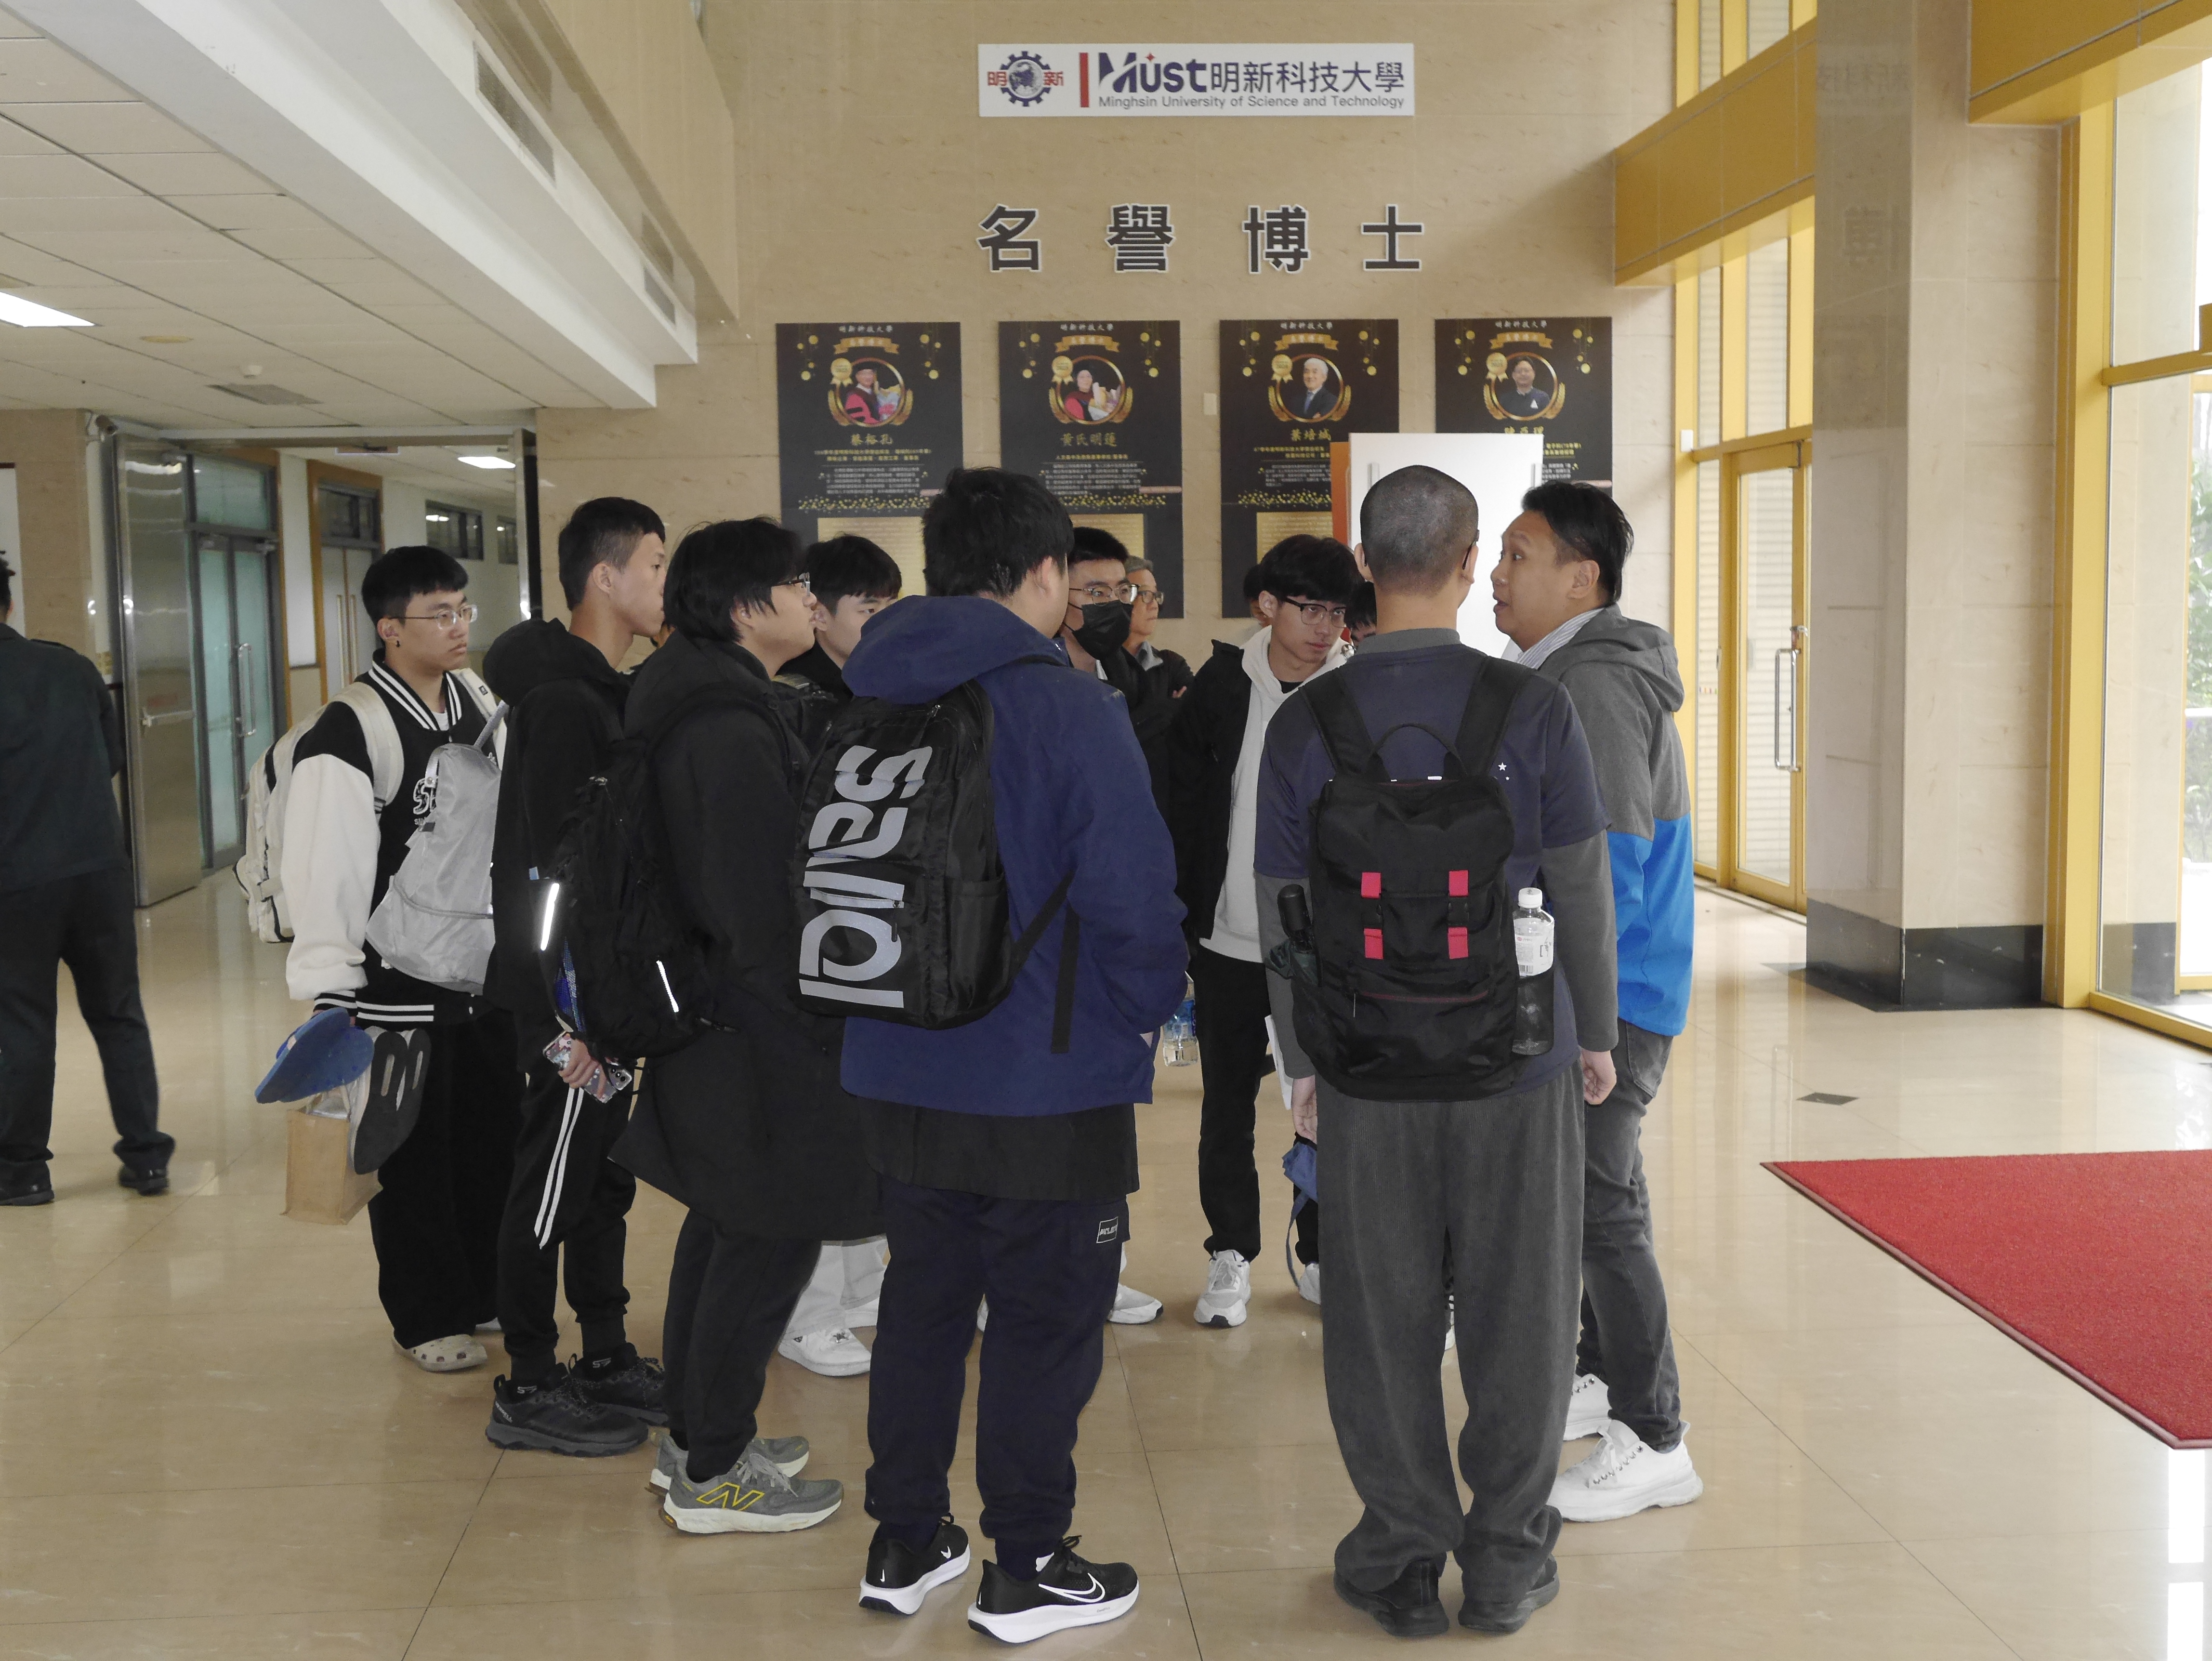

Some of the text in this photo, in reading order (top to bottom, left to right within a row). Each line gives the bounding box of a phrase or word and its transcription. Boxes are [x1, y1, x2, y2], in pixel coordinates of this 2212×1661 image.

[988, 71, 1064, 86] 明 新
[1211, 61, 1404, 92] 明新科技大學
[1099, 96, 1404, 109] Minghsin University of Science and Technology
[977, 203, 1424, 273] 名譽博士
